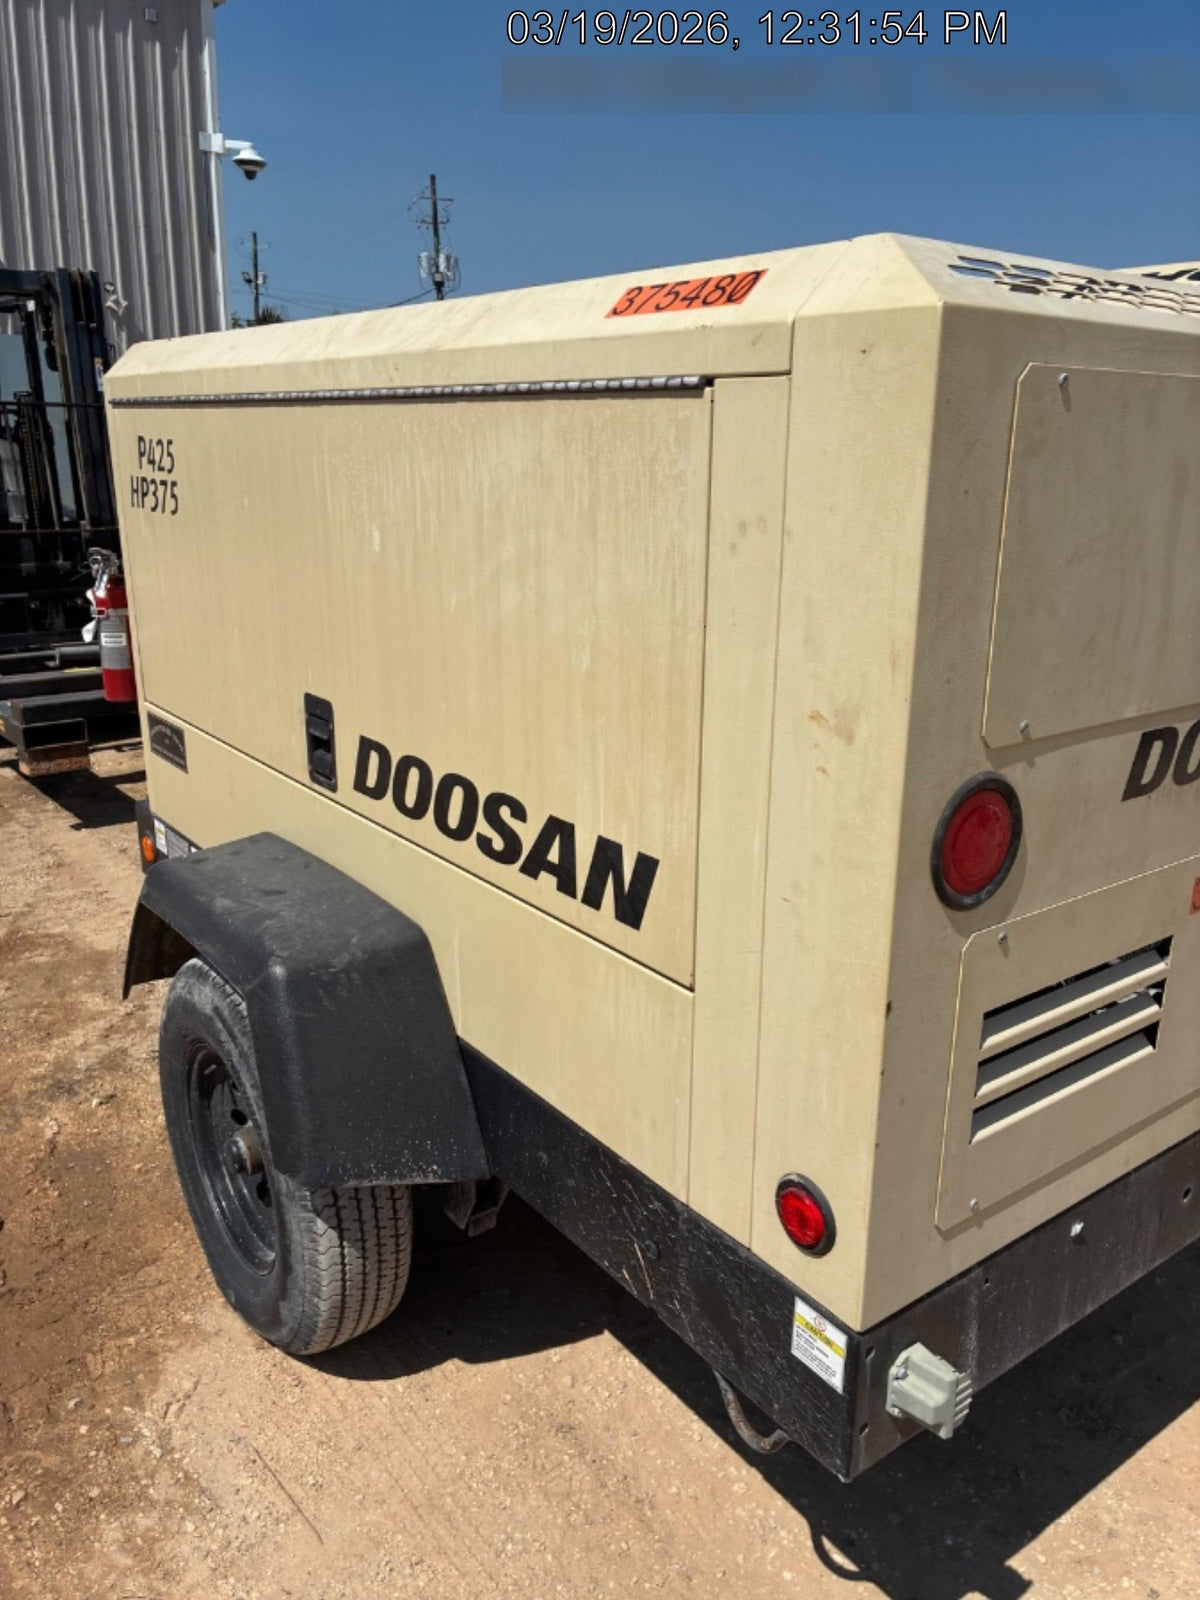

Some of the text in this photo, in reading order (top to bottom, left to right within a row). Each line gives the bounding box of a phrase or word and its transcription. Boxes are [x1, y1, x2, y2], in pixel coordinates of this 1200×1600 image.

[612, 269, 761, 316] 375480
[138, 435, 175, 474] P425
[130, 475, 179, 516] HP375
[353, 734, 660, 931] DOOSAN
